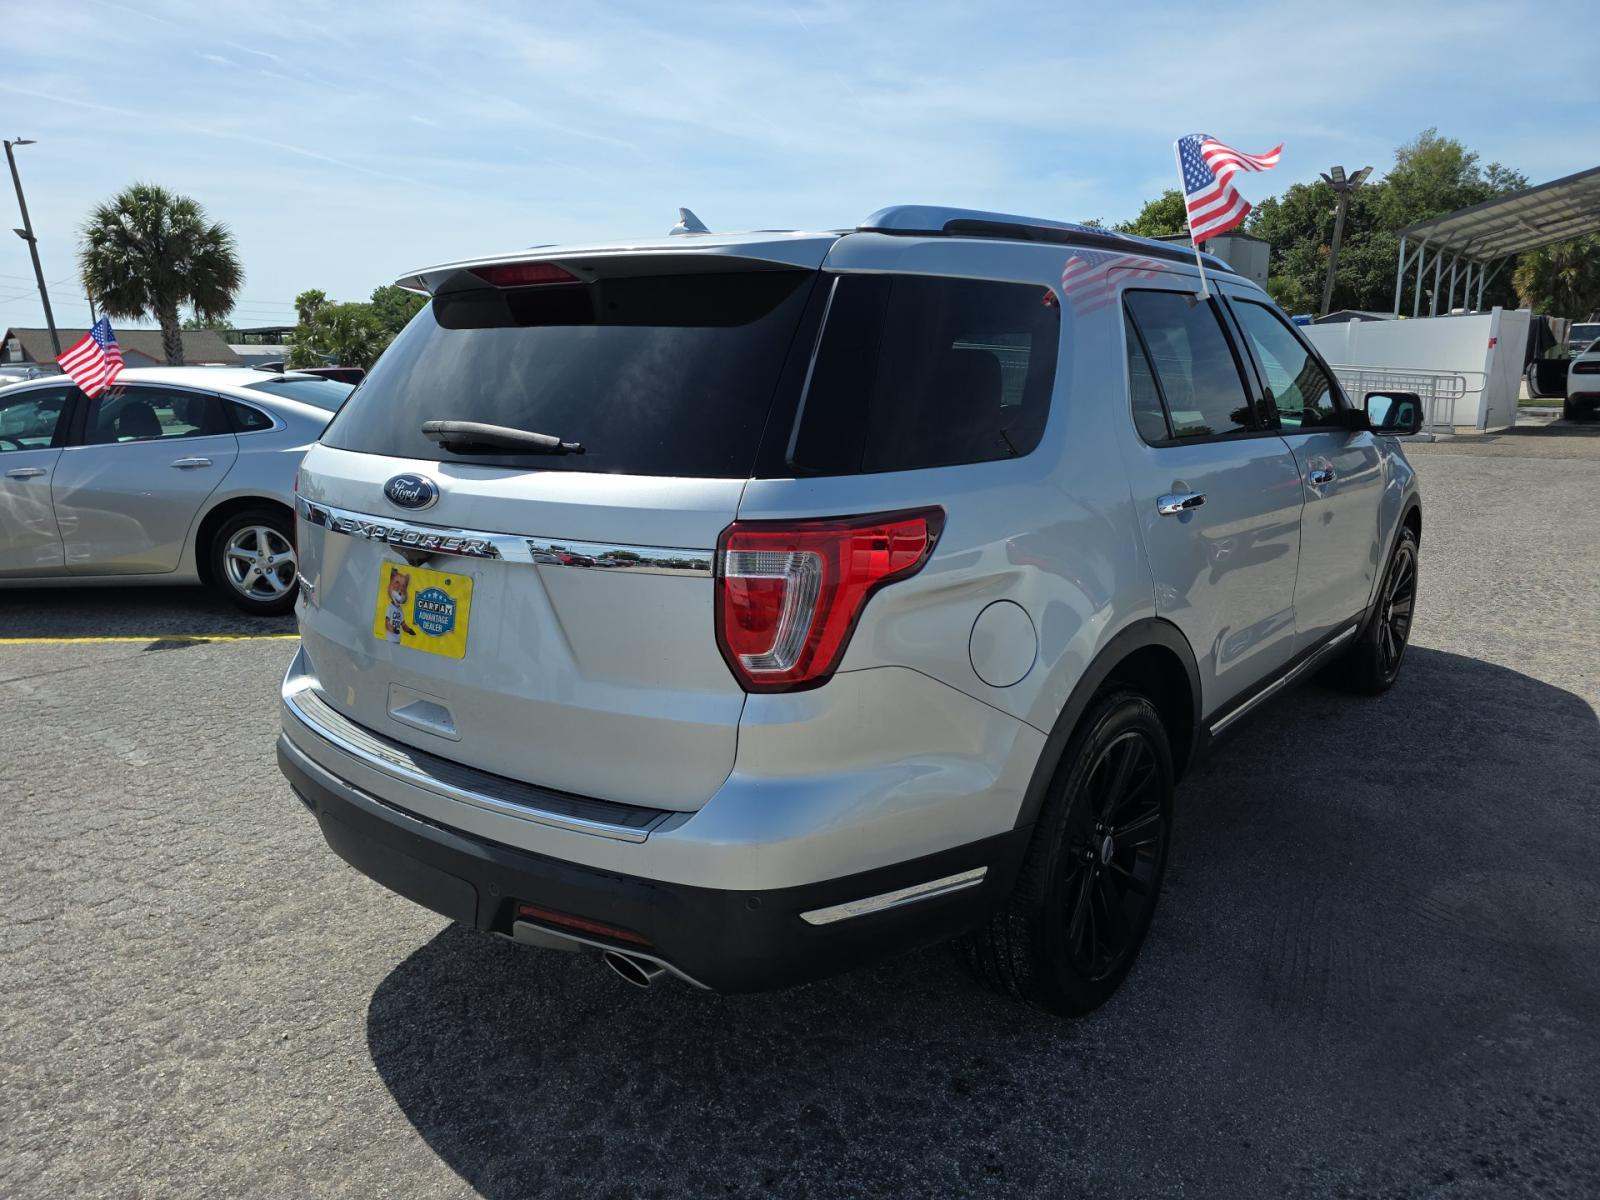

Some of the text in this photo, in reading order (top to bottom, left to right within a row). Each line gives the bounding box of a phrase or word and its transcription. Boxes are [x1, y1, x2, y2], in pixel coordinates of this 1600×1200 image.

[391, 478, 421, 502] Ford
[338, 517, 490, 554] EXPLORER
[418, 600, 453, 615] CARFAX
[419, 611, 449, 625] ADVANTAGE
[422, 621, 443, 632] DEALER
